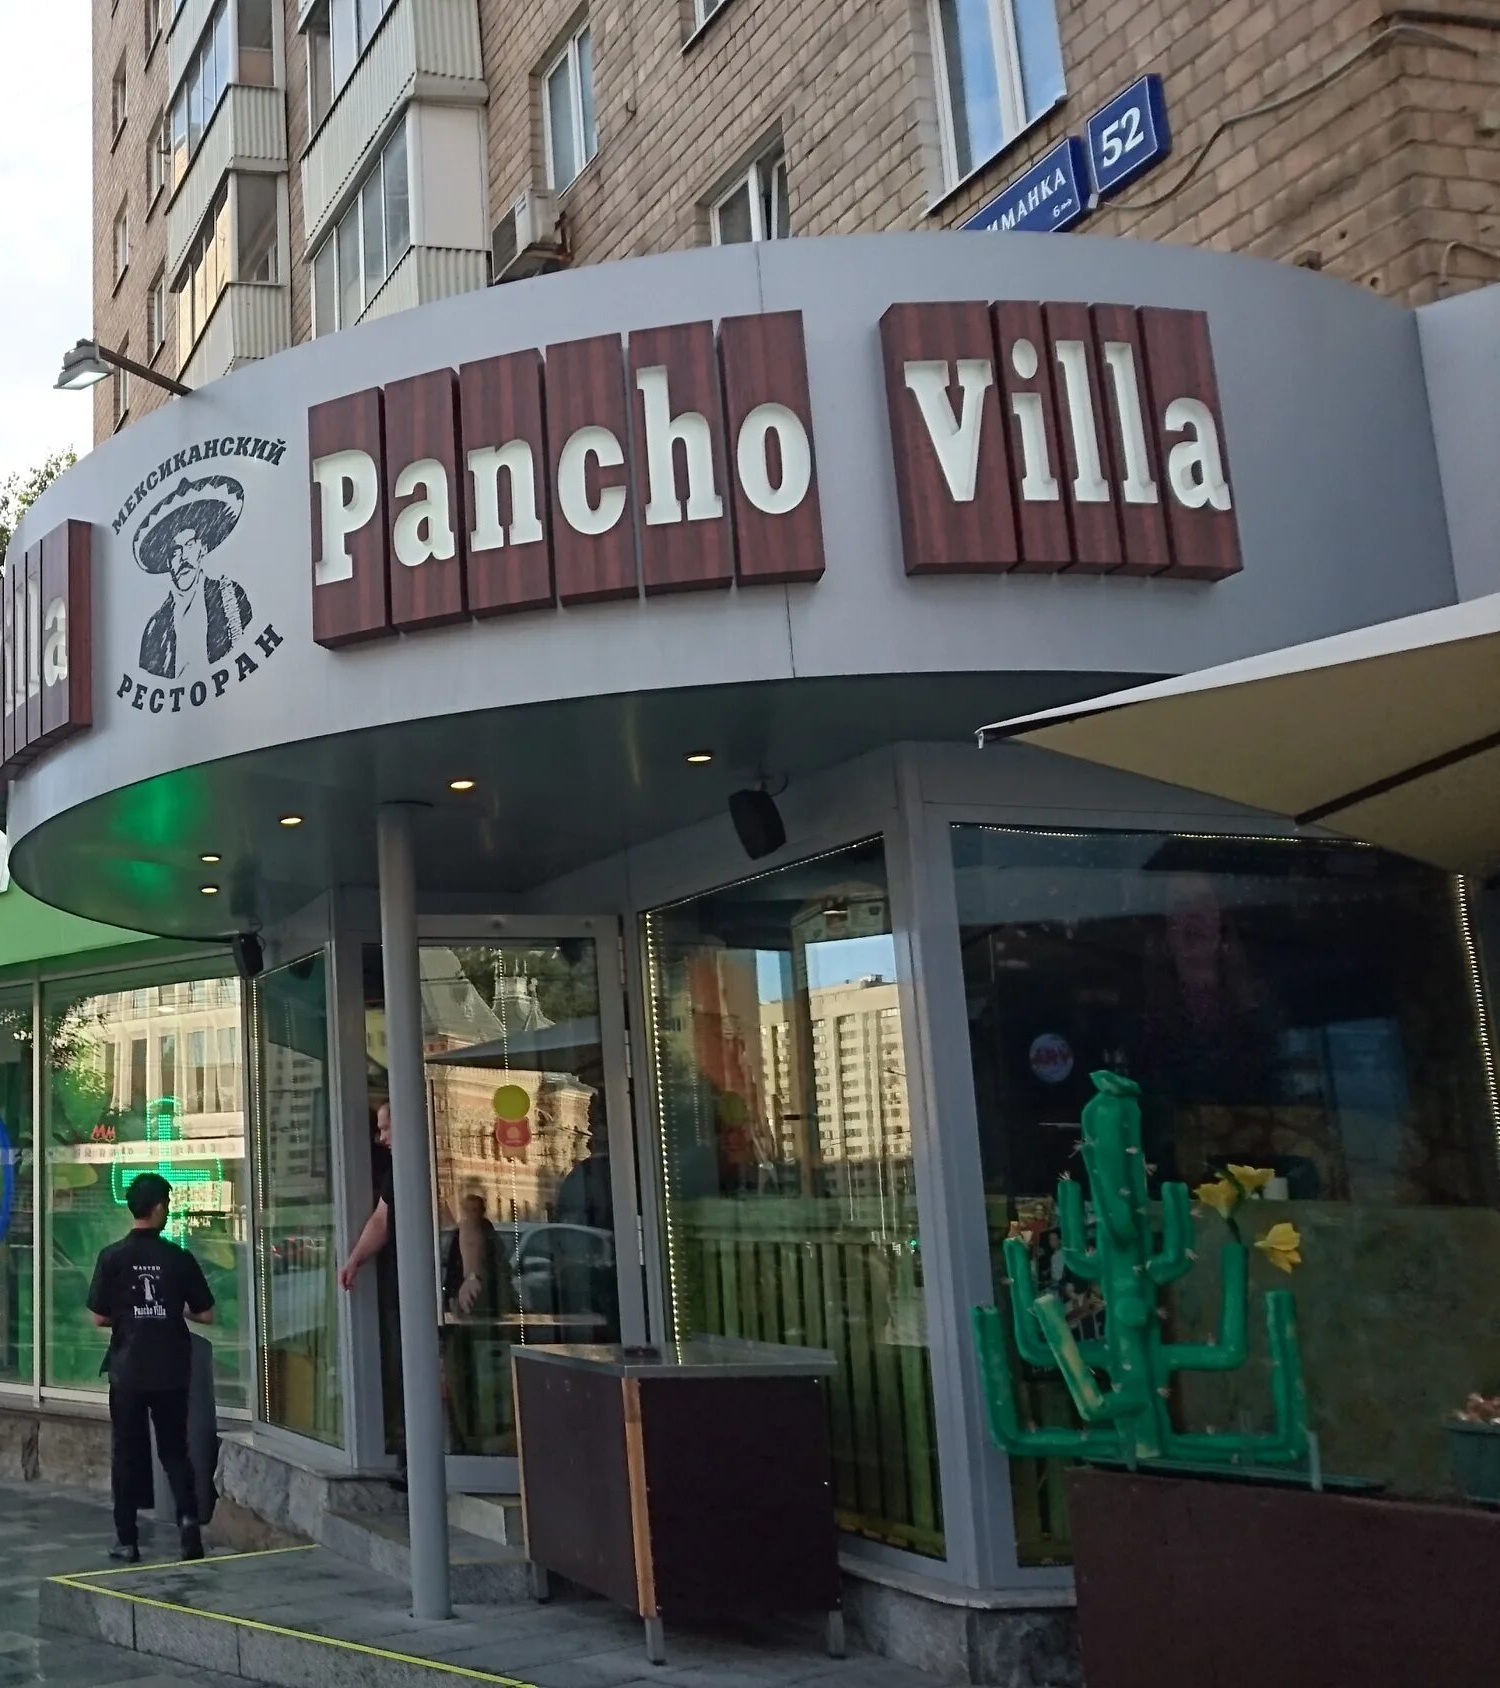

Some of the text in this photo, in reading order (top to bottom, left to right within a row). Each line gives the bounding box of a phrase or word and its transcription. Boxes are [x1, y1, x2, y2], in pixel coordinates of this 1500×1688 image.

[1102, 106, 1144, 167] 52
[112, 436, 287, 535] МЕКСИКАНСКИЙ
[312, 338, 1232, 587] Pancho Villa
[116, 624, 284, 714] РЕСТОРАН
